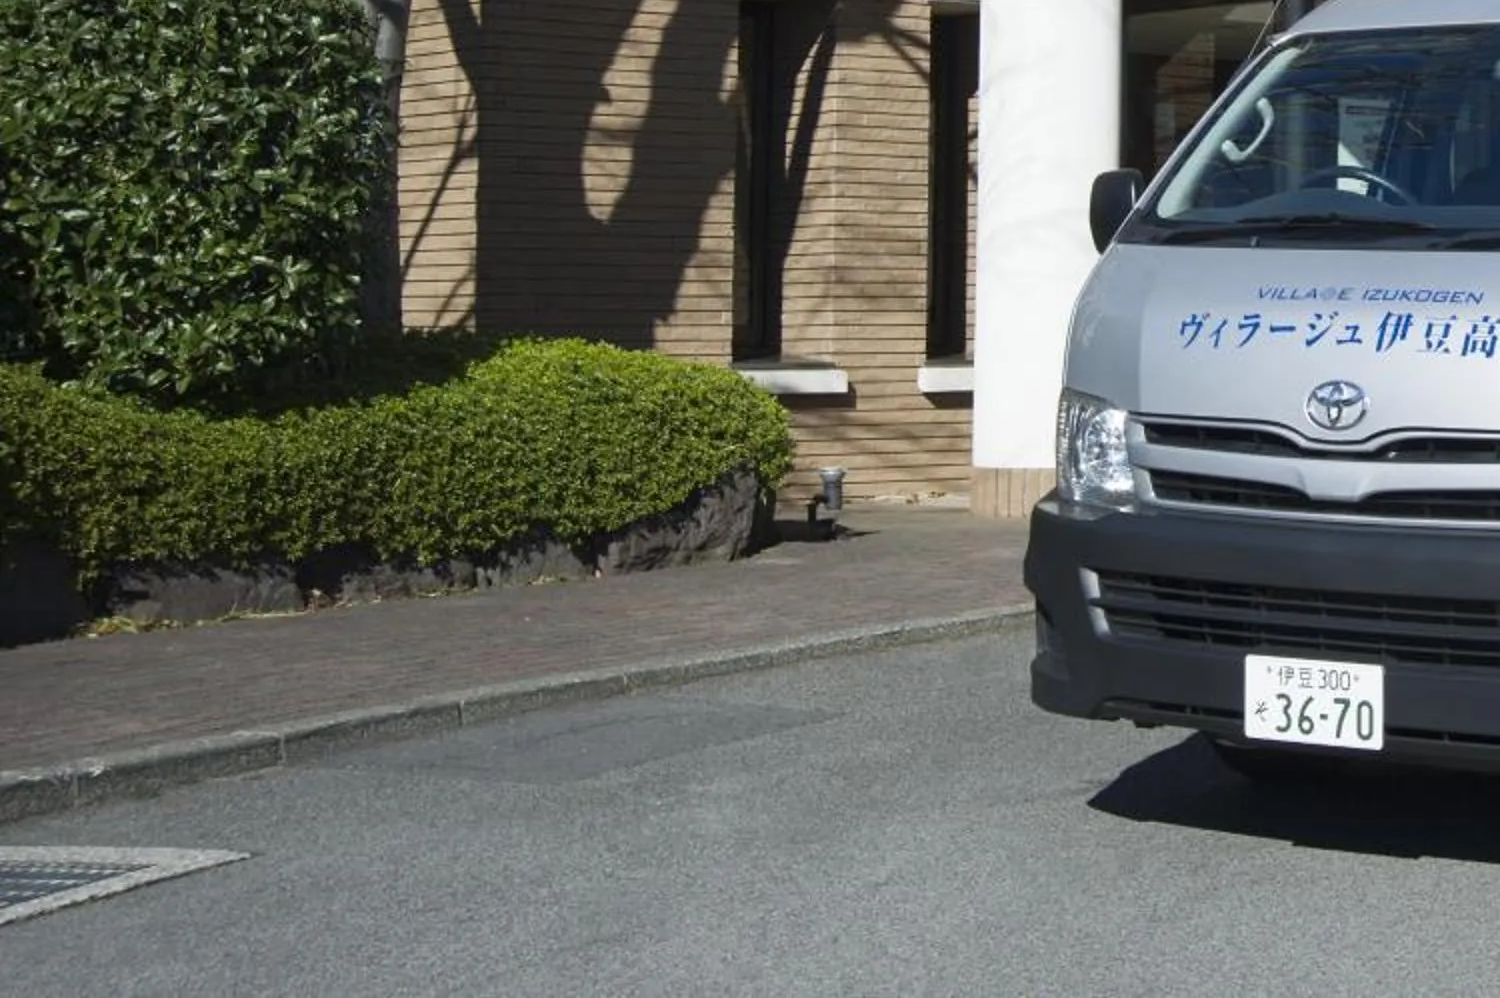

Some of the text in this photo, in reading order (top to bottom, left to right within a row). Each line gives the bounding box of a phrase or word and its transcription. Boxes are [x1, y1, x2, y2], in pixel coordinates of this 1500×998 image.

[1361, 288, 1485, 305] IZUKOGEN
[1277, 665, 1351, 691] 伊豆 300
[1275, 693, 1374, 741] 36-70
